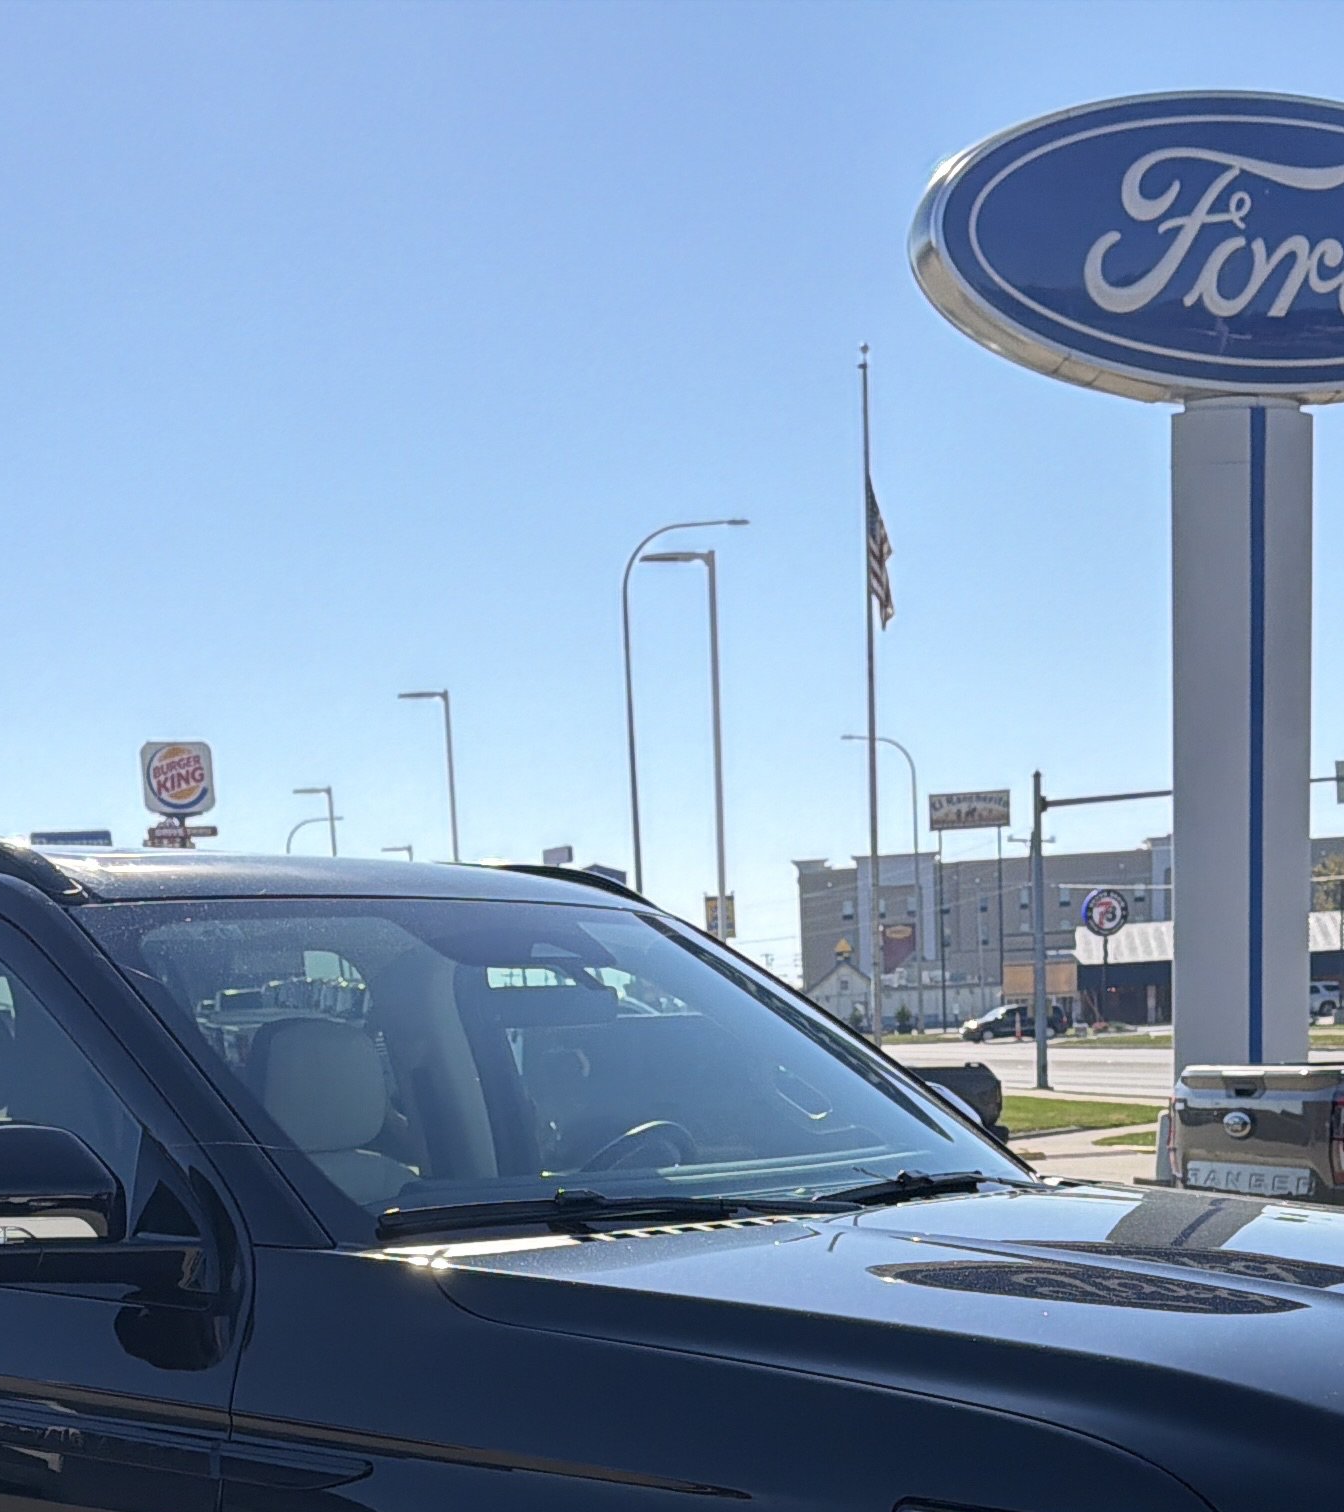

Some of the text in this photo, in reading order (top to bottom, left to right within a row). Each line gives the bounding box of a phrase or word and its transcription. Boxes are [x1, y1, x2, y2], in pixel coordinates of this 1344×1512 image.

[152, 755, 202, 780] BURGER
[156, 766, 205, 797] KING
[1187, 1167, 1316, 1195] RANGER
